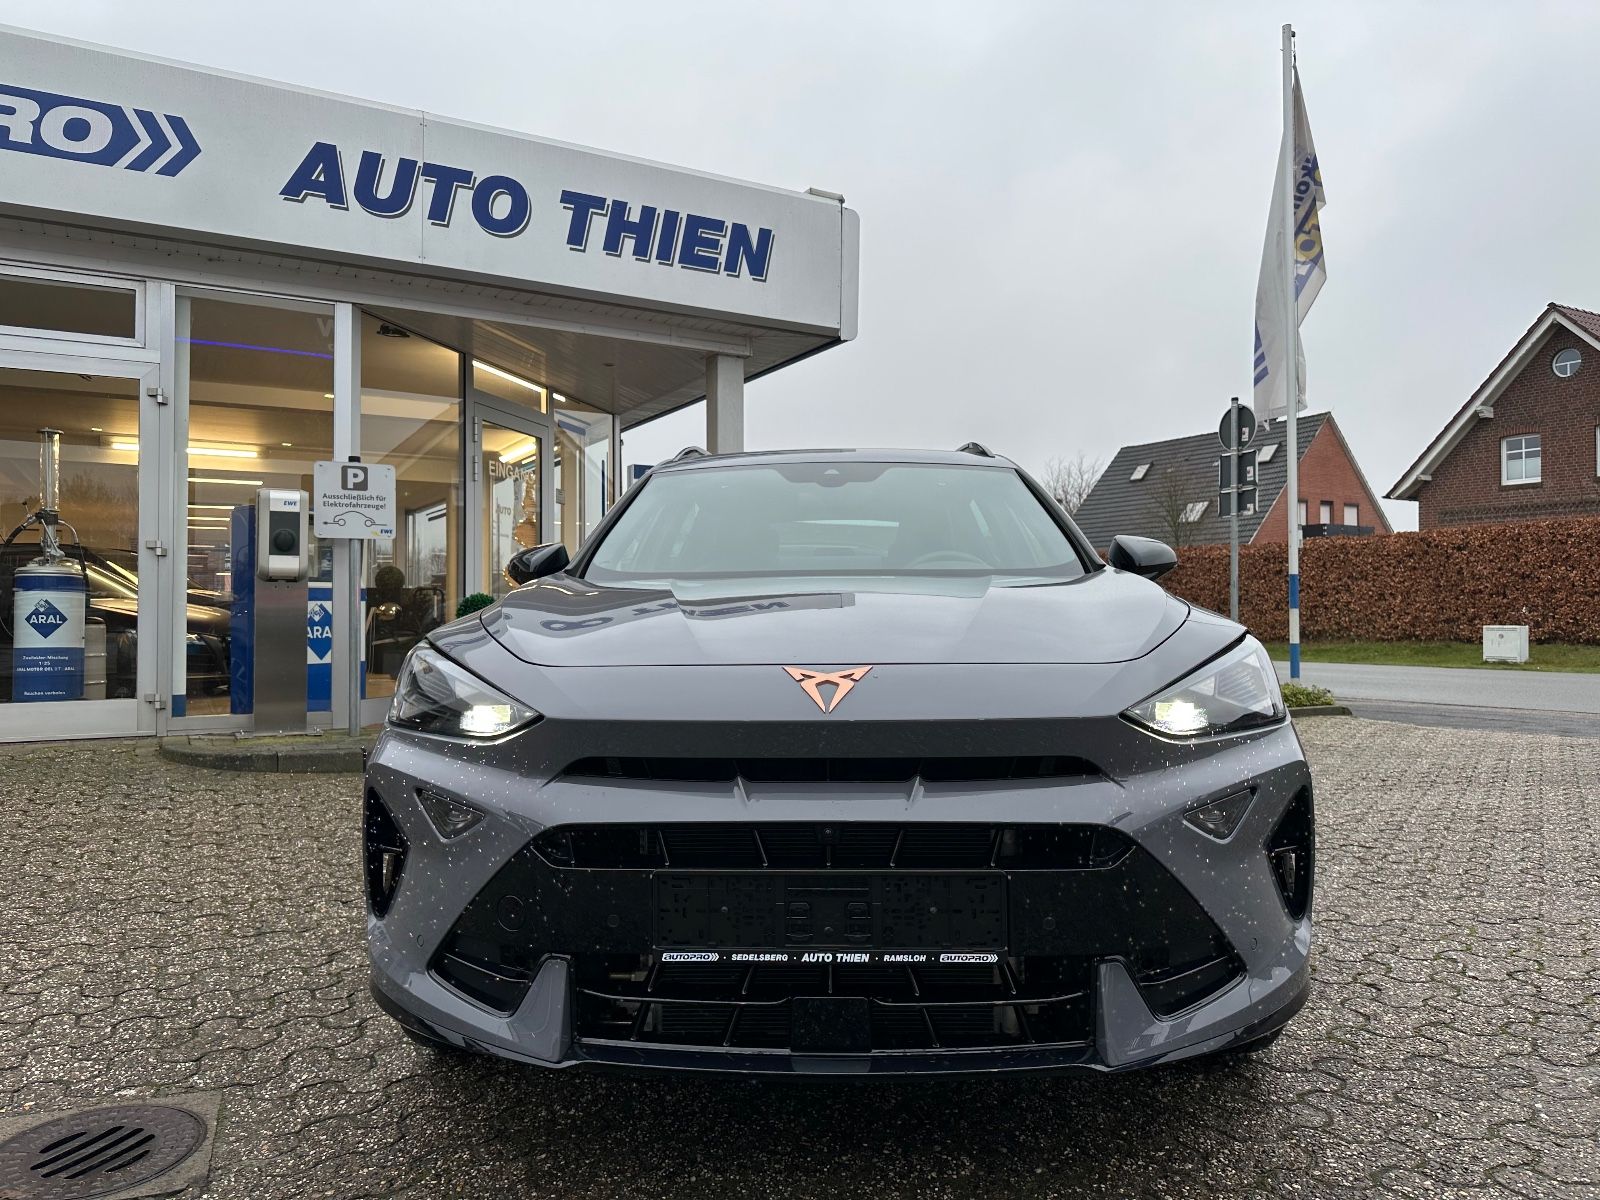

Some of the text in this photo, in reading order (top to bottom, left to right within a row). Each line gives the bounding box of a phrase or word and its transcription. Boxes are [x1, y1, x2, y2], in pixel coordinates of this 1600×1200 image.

[279, 141, 775, 282] AUTO THIEN
[347, 468, 365, 489] P
[322, 493, 375, 502] Ausschließlich
[322, 501, 387, 511] Elektrofahrzeuge!
[29, 614, 63, 624] ARAL
[731, 953, 789, 962] SEDELSBERG
[801, 952, 833, 962] AUTO
[835, 953, 870, 963] THIEN
[883, 954, 927, 962] RAMSLOH
